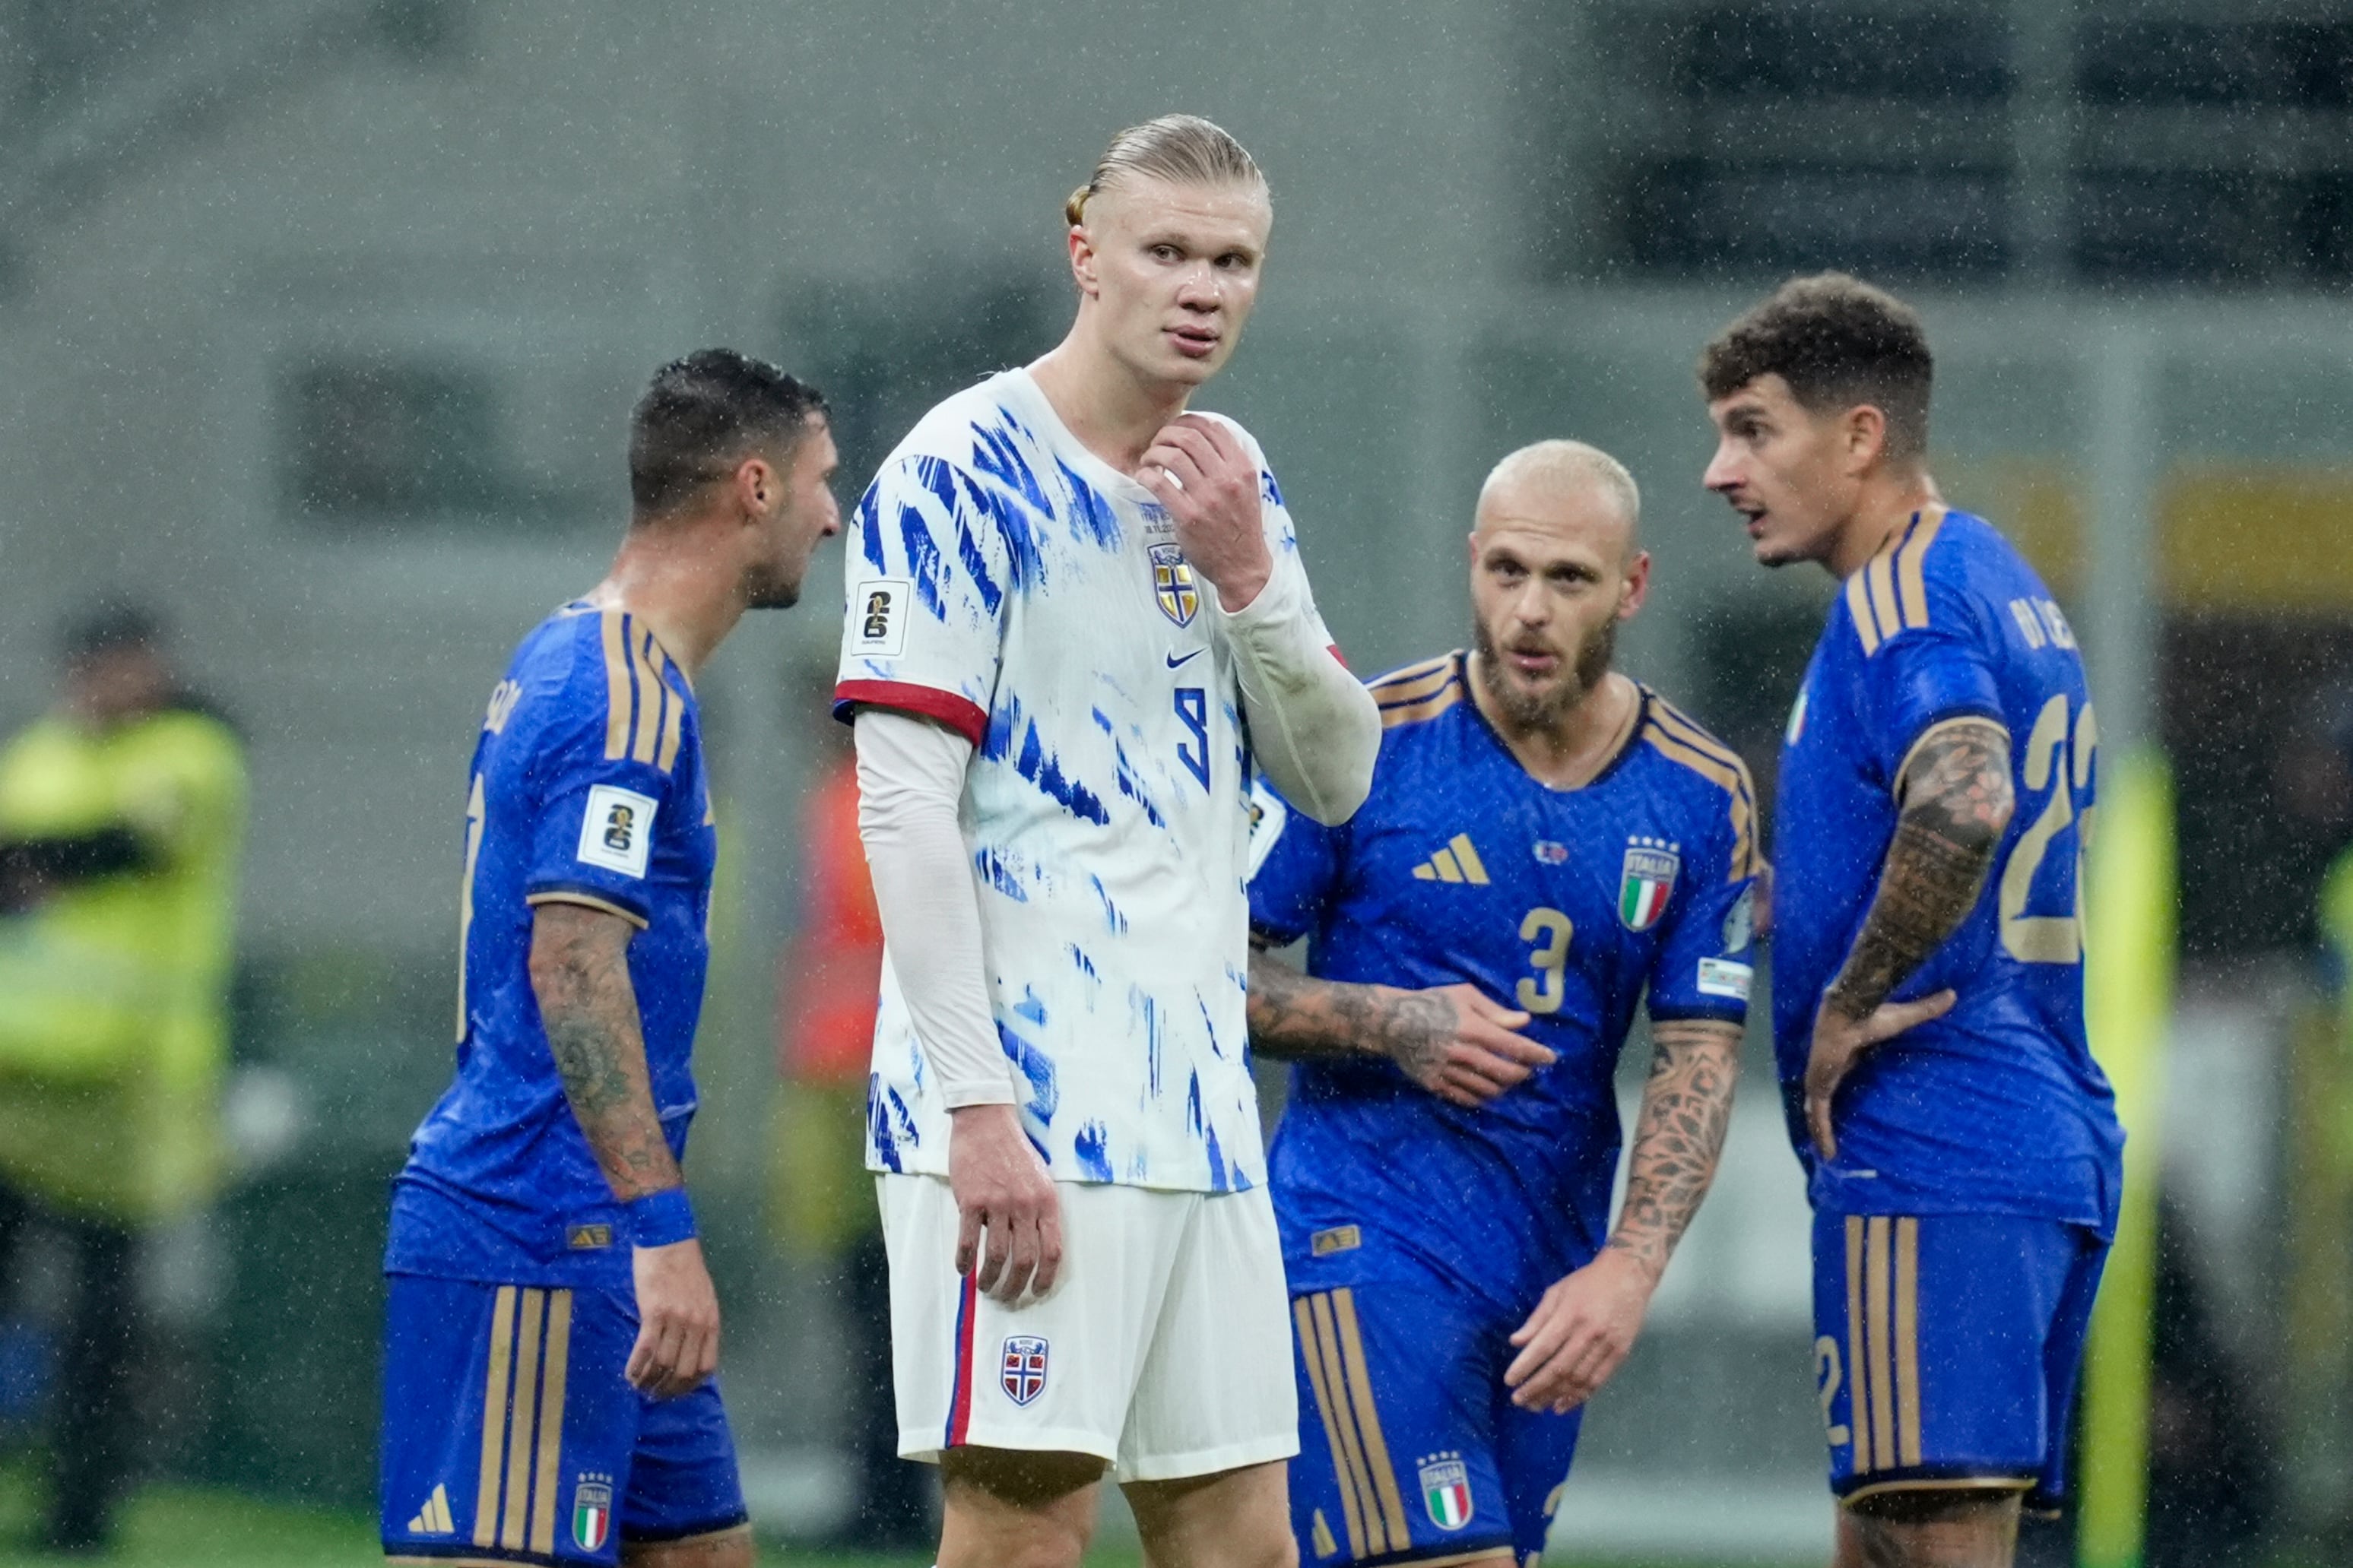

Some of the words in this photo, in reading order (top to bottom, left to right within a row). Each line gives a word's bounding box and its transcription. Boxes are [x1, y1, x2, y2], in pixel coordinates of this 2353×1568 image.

[1174, 687, 1210, 796] 9
[1627, 853, 1674, 877] ITALIA
[1516, 907, 1573, 1015] 3
